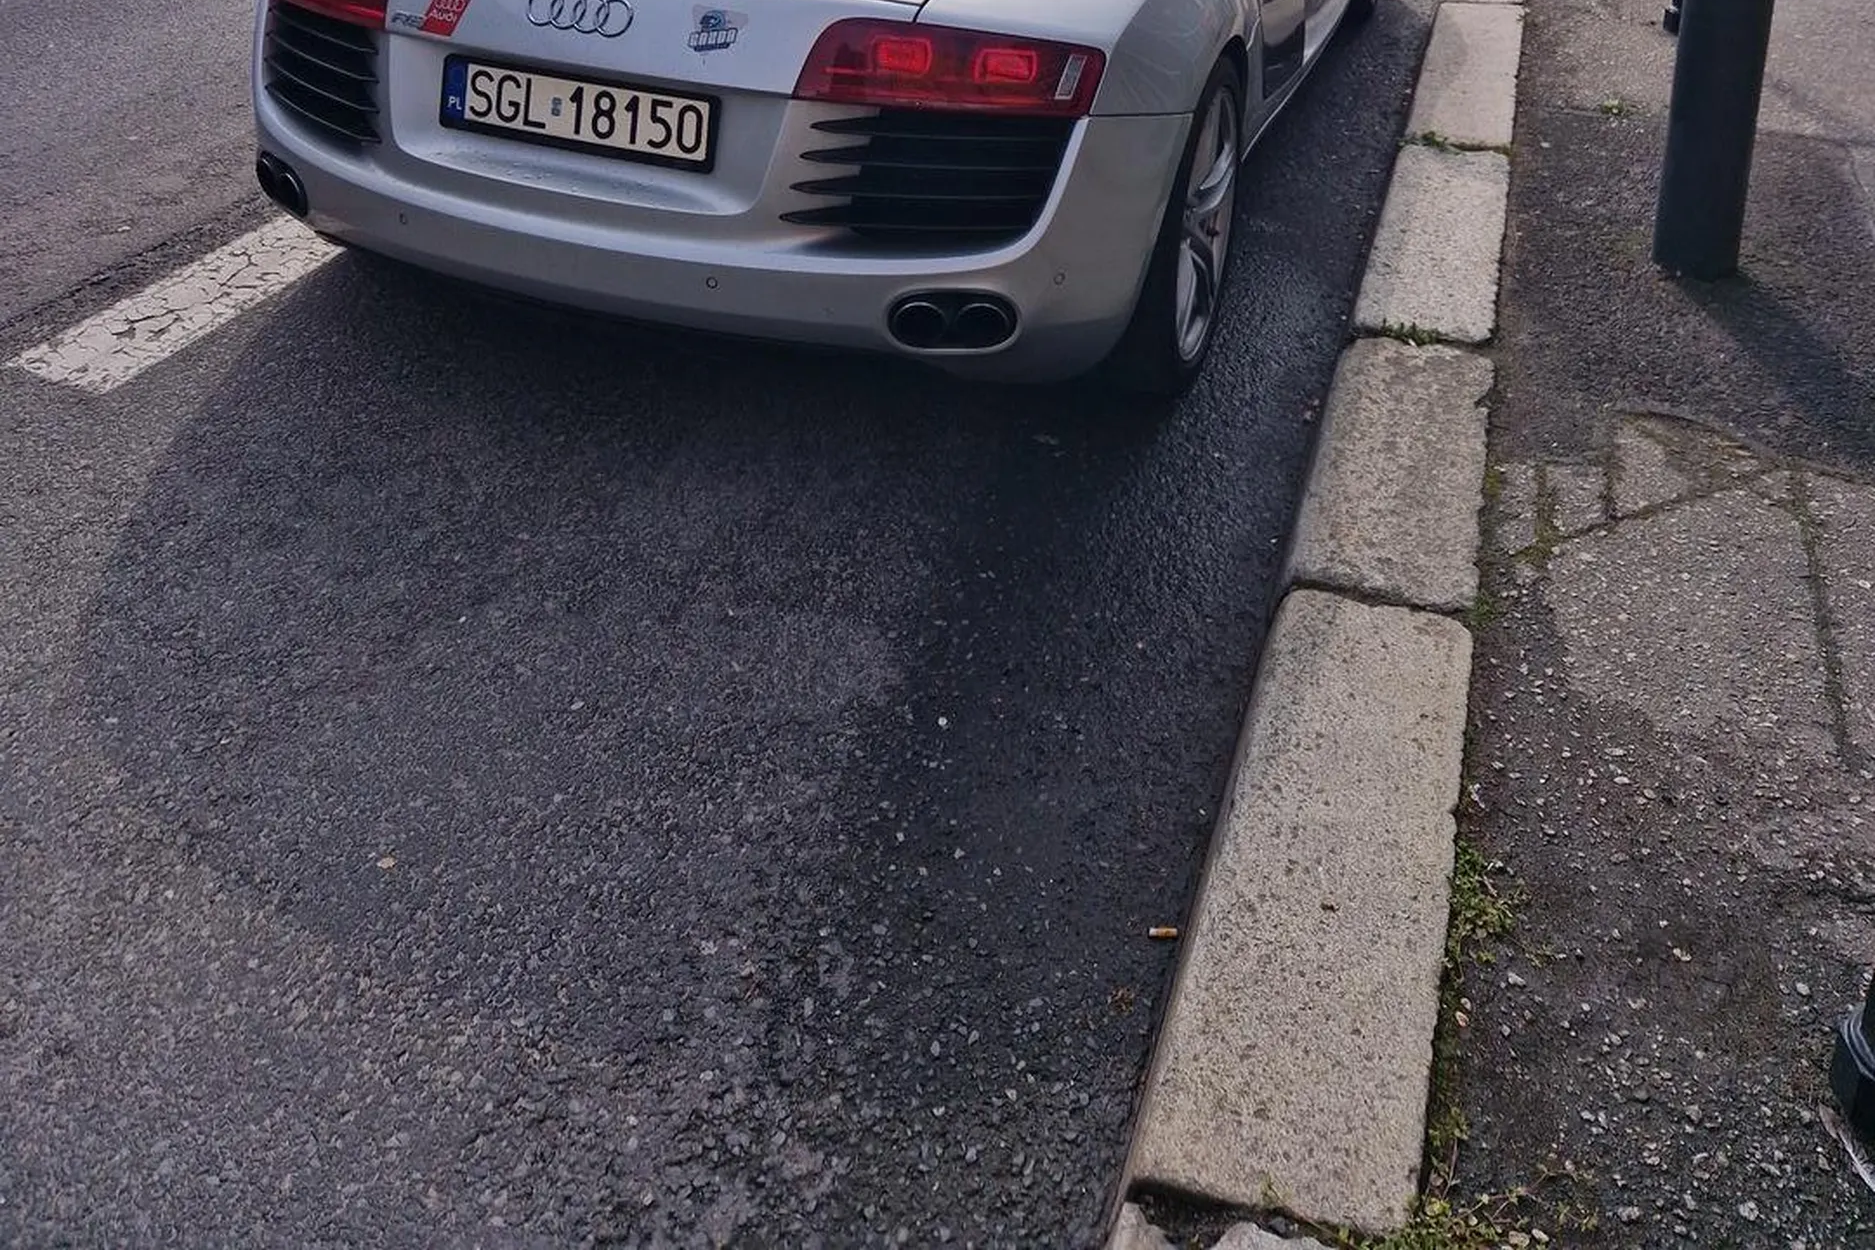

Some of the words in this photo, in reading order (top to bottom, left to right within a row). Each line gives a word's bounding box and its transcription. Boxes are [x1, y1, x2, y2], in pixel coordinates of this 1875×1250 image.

[447, 95, 462, 111] PL
[468, 69, 546, 129] SGL
[569, 85, 705, 154] 18150
